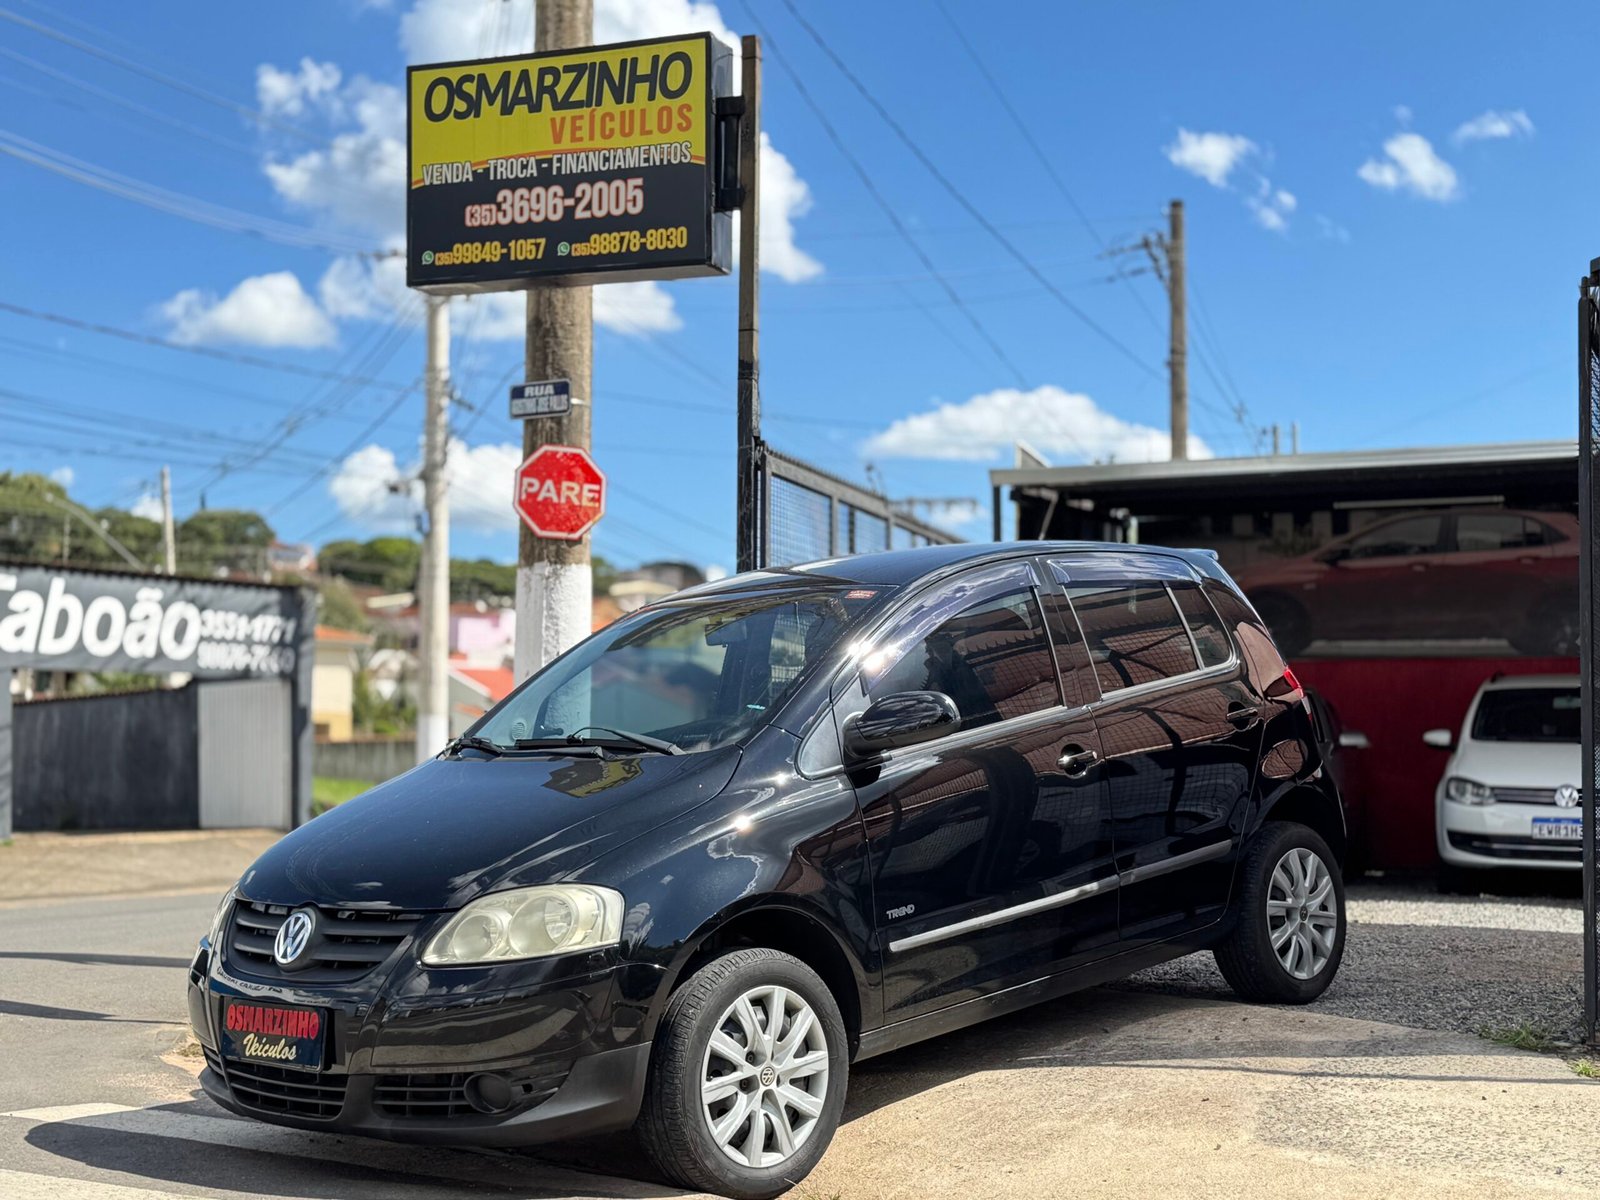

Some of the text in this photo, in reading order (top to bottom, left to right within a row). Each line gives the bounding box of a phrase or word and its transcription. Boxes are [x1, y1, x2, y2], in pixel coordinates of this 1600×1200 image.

[424, 51, 693, 122] OSMARZINHO
[550, 103, 693, 145] VEÍCULOS
[422, 161, 474, 186] VENDA
[487, 156, 538, 181] TROCA
[552, 141, 693, 176] FINANCIAMENTOS
[465, 177, 645, 228] (35)3696-2005
[524, 384, 555, 398] RUA
[520, 477, 600, 508] PARE
[886, 904, 915, 920] TREND
[226, 1004, 320, 1040] OSMARZINHO
